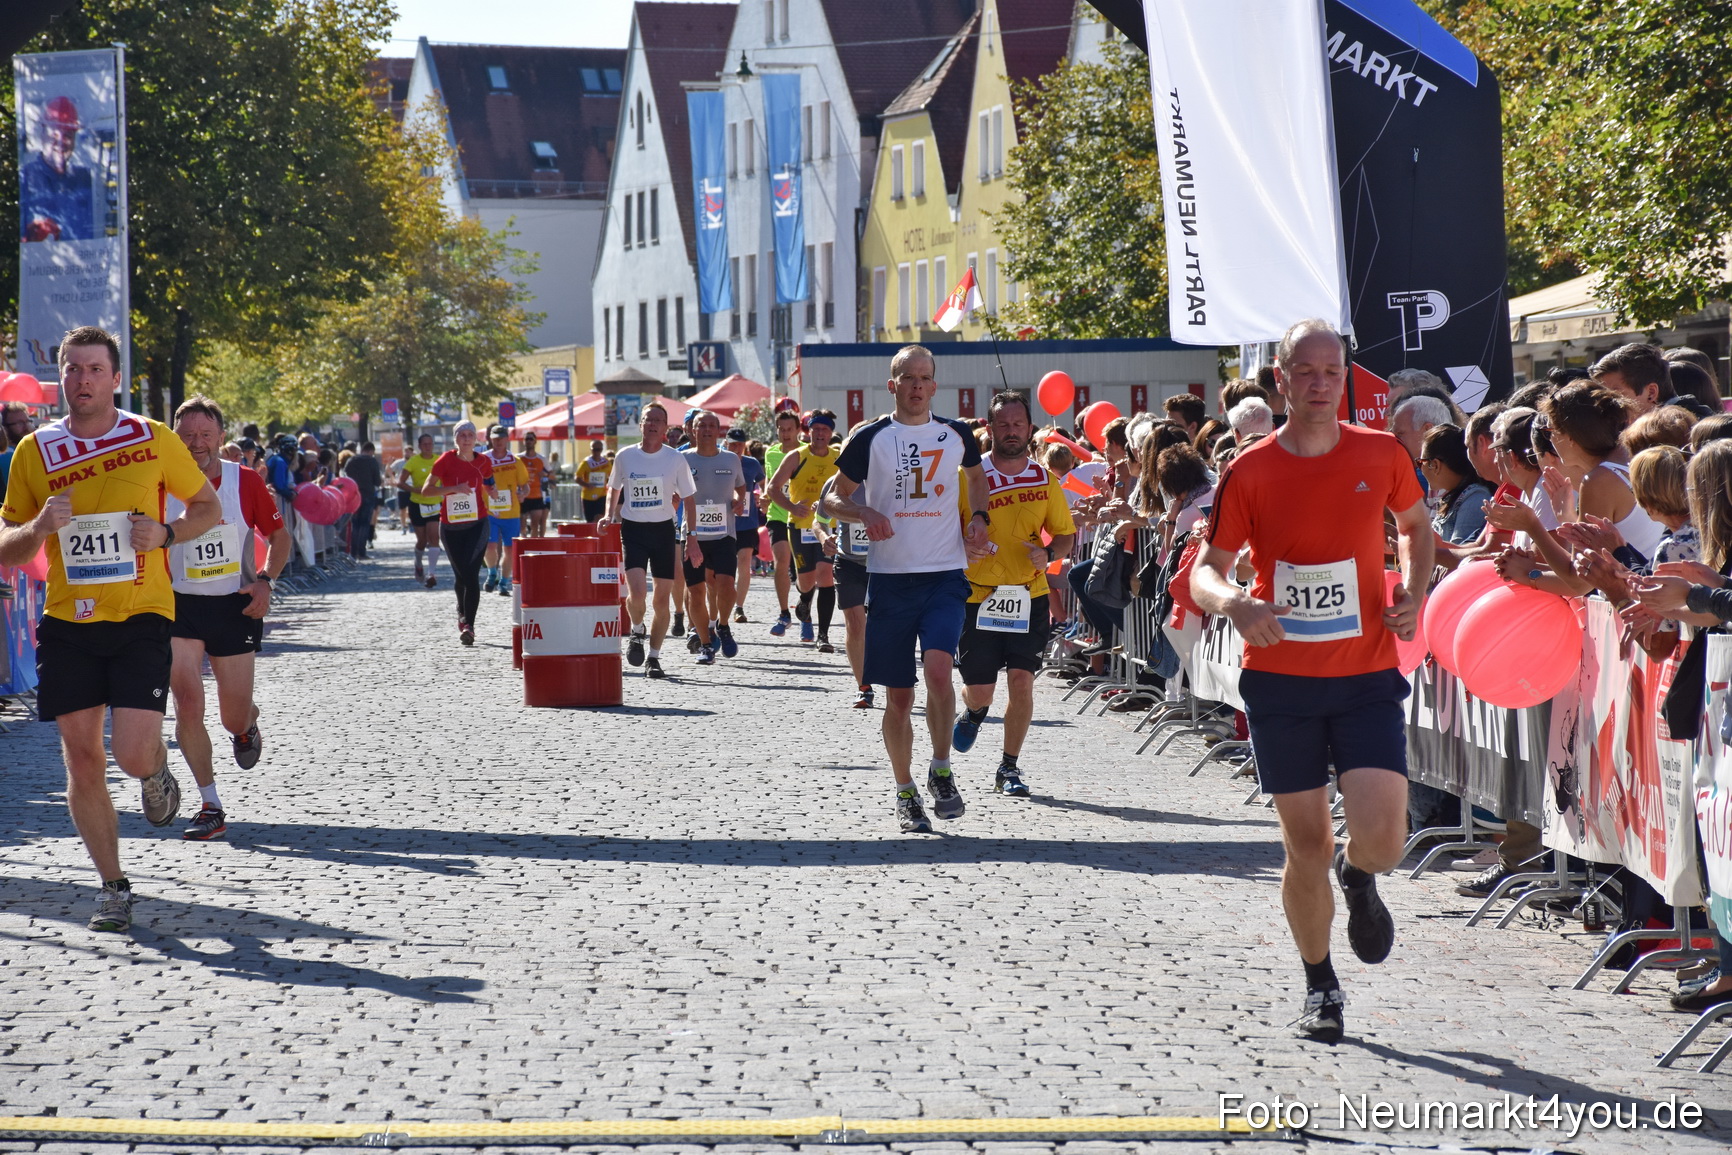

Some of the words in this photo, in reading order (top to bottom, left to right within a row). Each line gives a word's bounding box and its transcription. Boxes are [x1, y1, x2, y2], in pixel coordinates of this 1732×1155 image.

[1326, 22, 1439, 107] MARKT
[904, 227, 925, 254] HOTEL
[48, 465, 98, 492] MAX
[102, 447, 158, 473] BÖGL
[901, 452, 909, 477] LAUF
[633, 486, 659, 497] 3114
[1018, 489, 1049, 503] BÖGL
[452, 501, 470, 511] 266
[78, 519, 110, 530] BOCK
[699, 513, 723, 523] 2266
[69, 532, 120, 556] 2411
[195, 541, 224, 561] 191
[78, 566, 119, 577] Christian
[201, 567, 224, 577] Rainer
[1294, 571, 1333, 581] BOCK
[1286, 583, 1345, 610] 3125
[986, 598, 1022, 614] 2401
[592, 617, 621, 638] AVI
[992, 619, 1015, 628] Ronald
